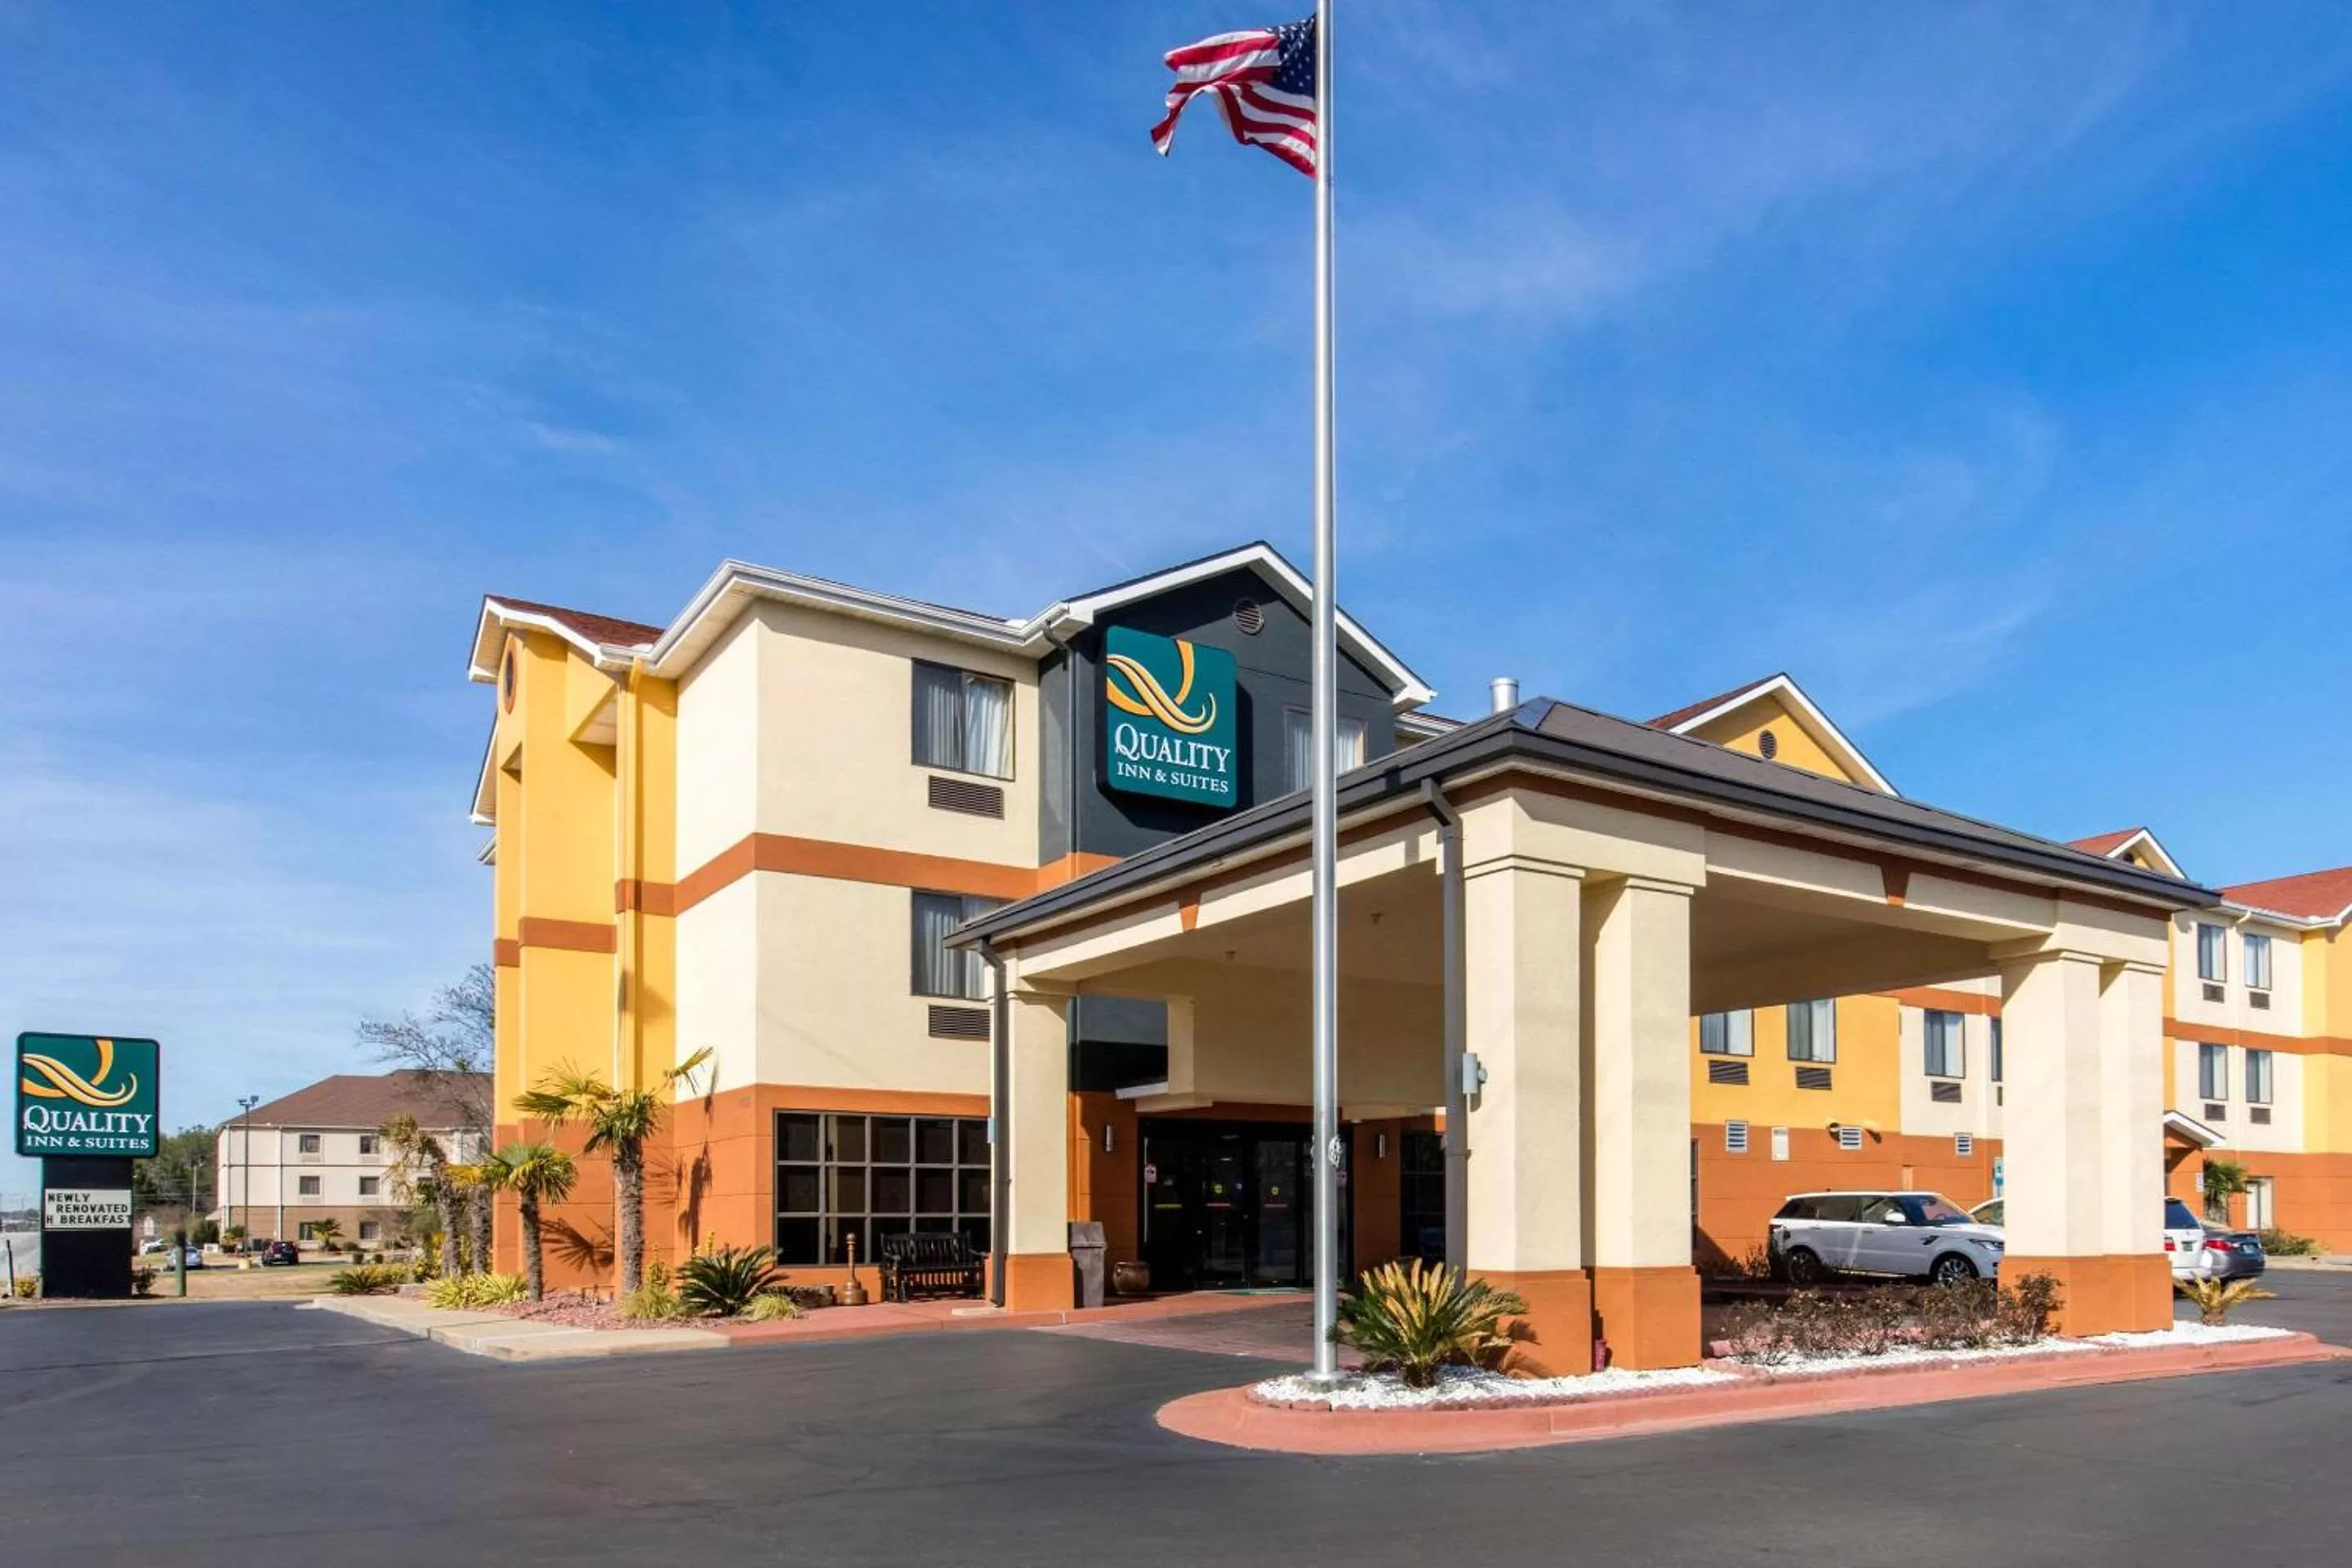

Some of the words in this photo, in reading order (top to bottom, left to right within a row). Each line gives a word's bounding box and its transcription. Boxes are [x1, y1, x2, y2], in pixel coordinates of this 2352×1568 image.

[1114, 723, 1232, 773] QUALITY
[1116, 761, 1151, 781] INN
[1155, 768, 1166, 783] &
[1170, 772, 1229, 794] SUITES
[23, 1105, 153, 1134] QUALITY
[26, 1135, 64, 1147] INN
[68, 1136, 81, 1147] &
[85, 1137, 149, 1149] SUITES
[48, 1193, 90, 1202] NEWLY
[56, 1204, 128, 1213] RENOVATED
[60, 1214, 131, 1224] BREAKFAST
